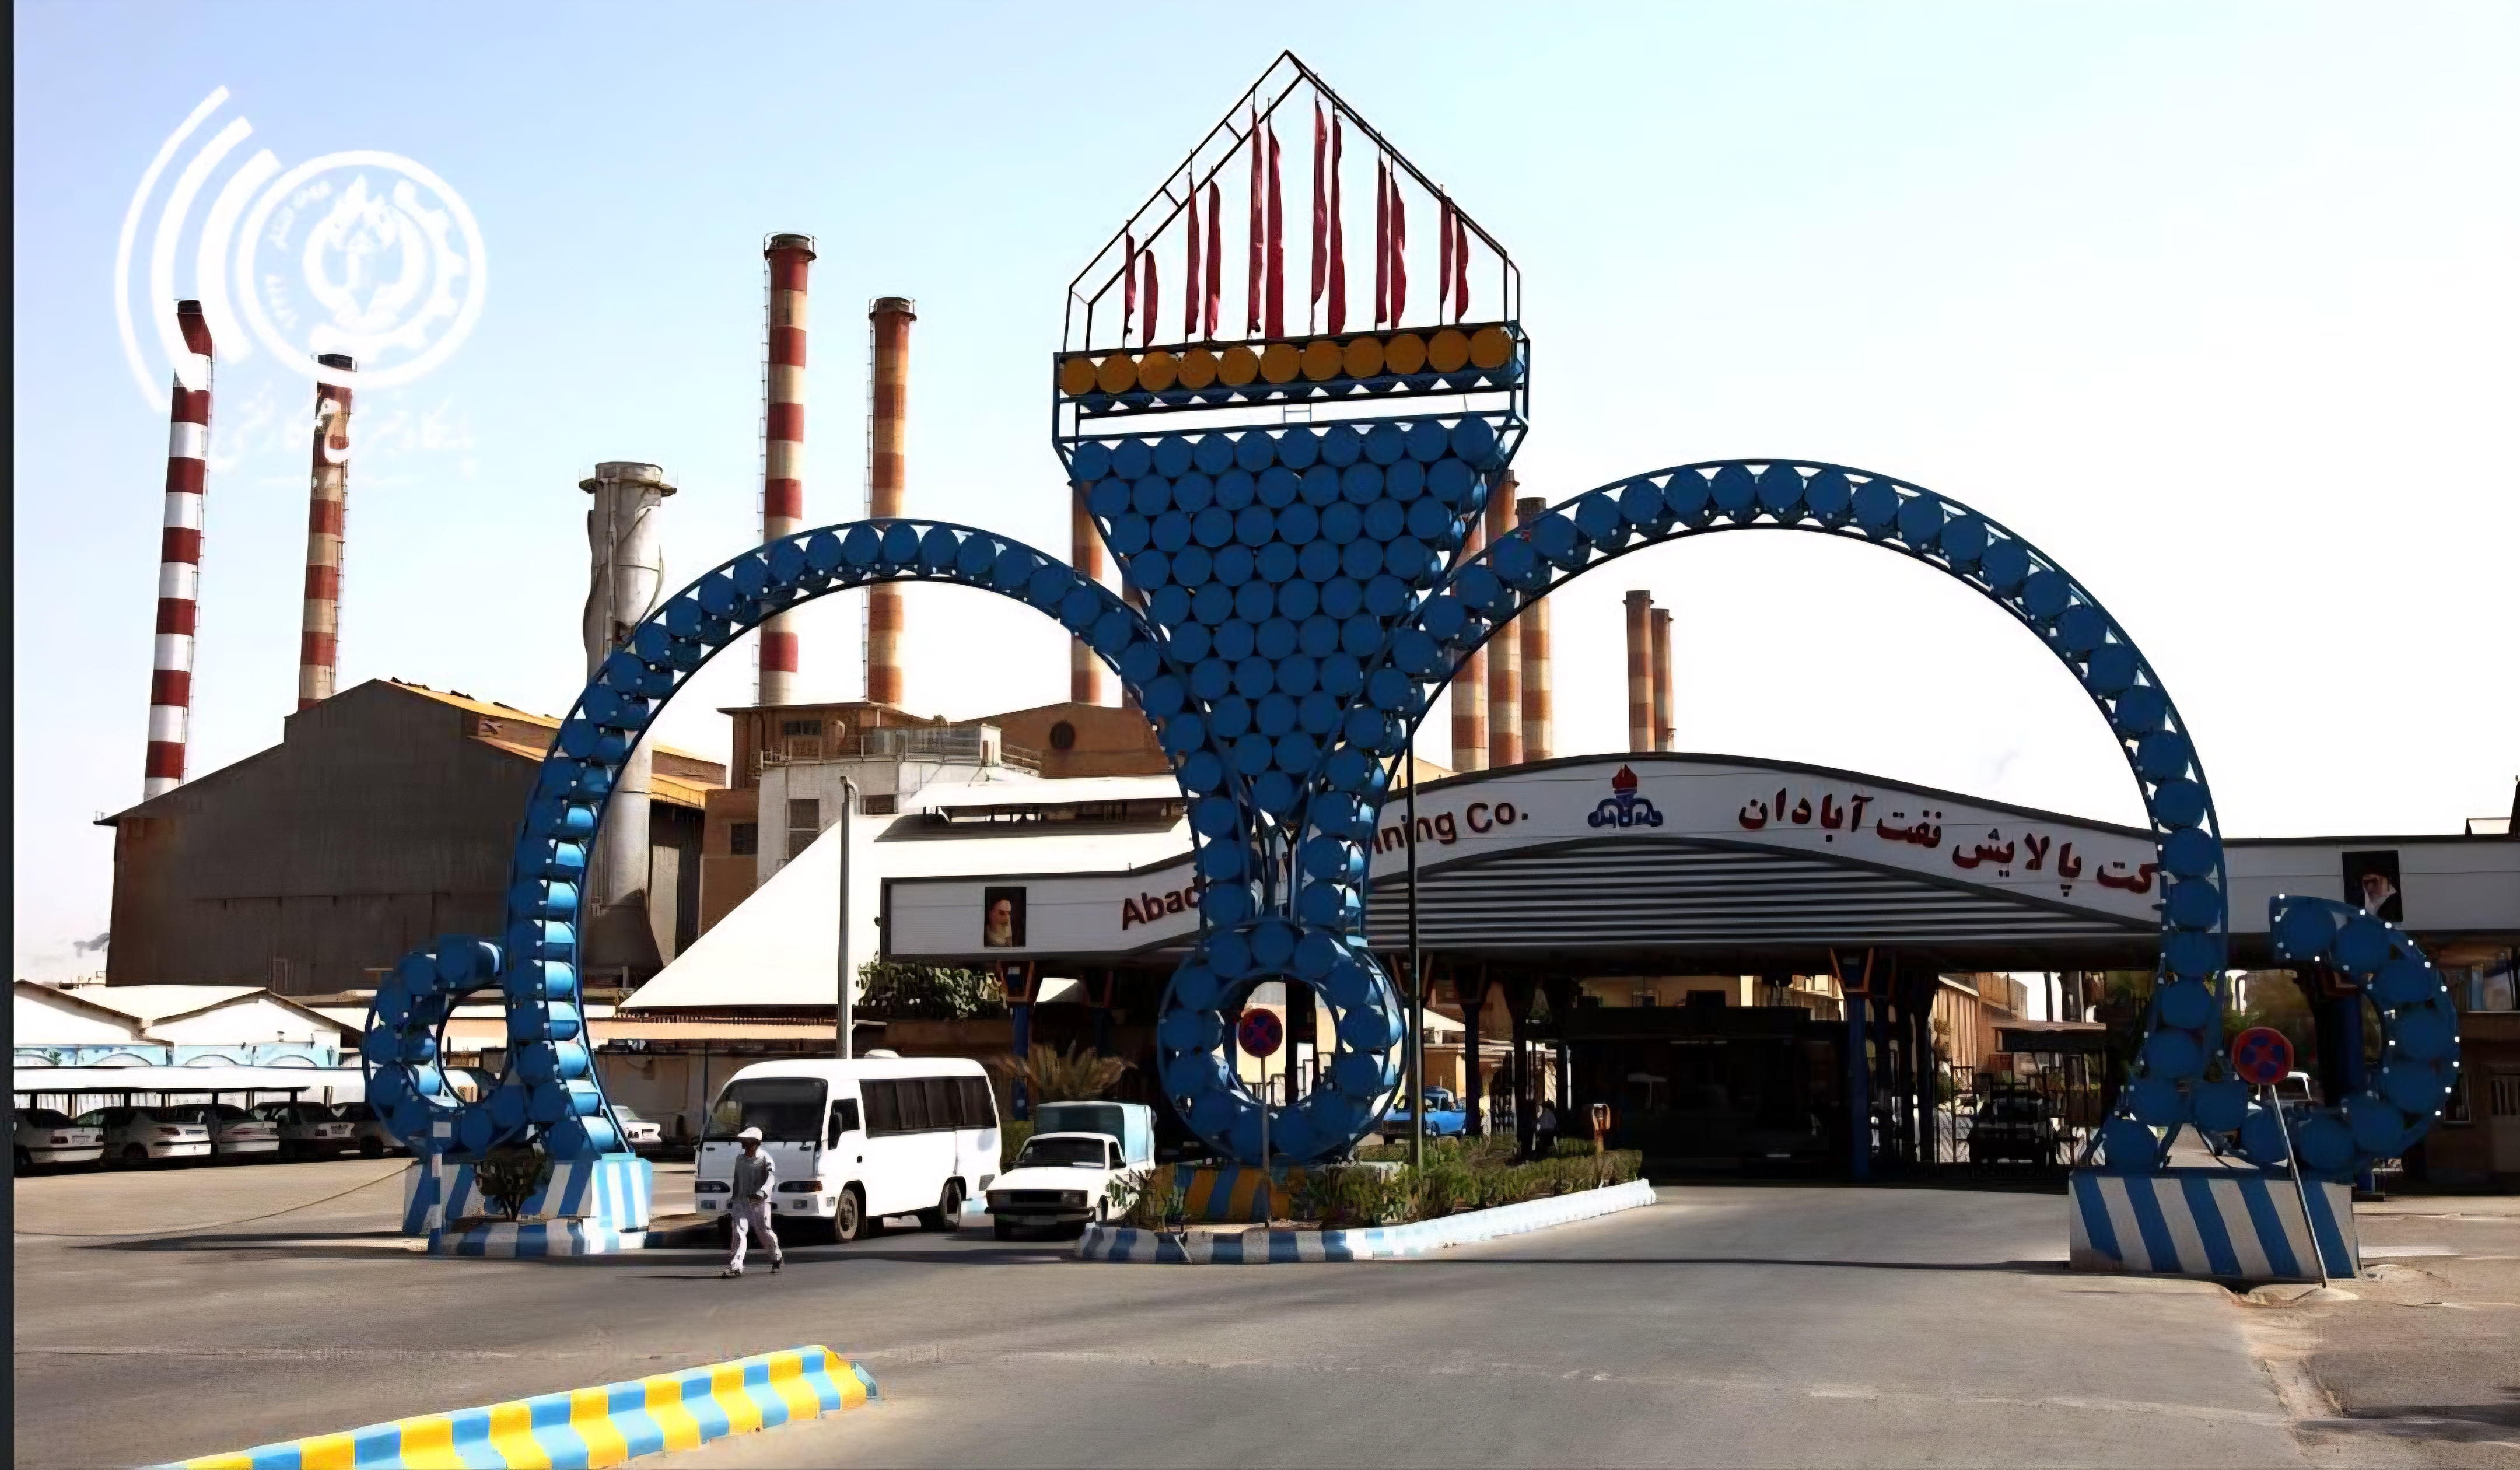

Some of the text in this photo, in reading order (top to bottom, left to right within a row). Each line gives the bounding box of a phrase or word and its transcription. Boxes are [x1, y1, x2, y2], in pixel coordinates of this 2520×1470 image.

[1466, 802, 1529, 834] Co.
[1738, 787, 1874, 842] آبادان
[1876, 810, 1943, 848] نفت
[1952, 828, 2082, 897] پالایش
